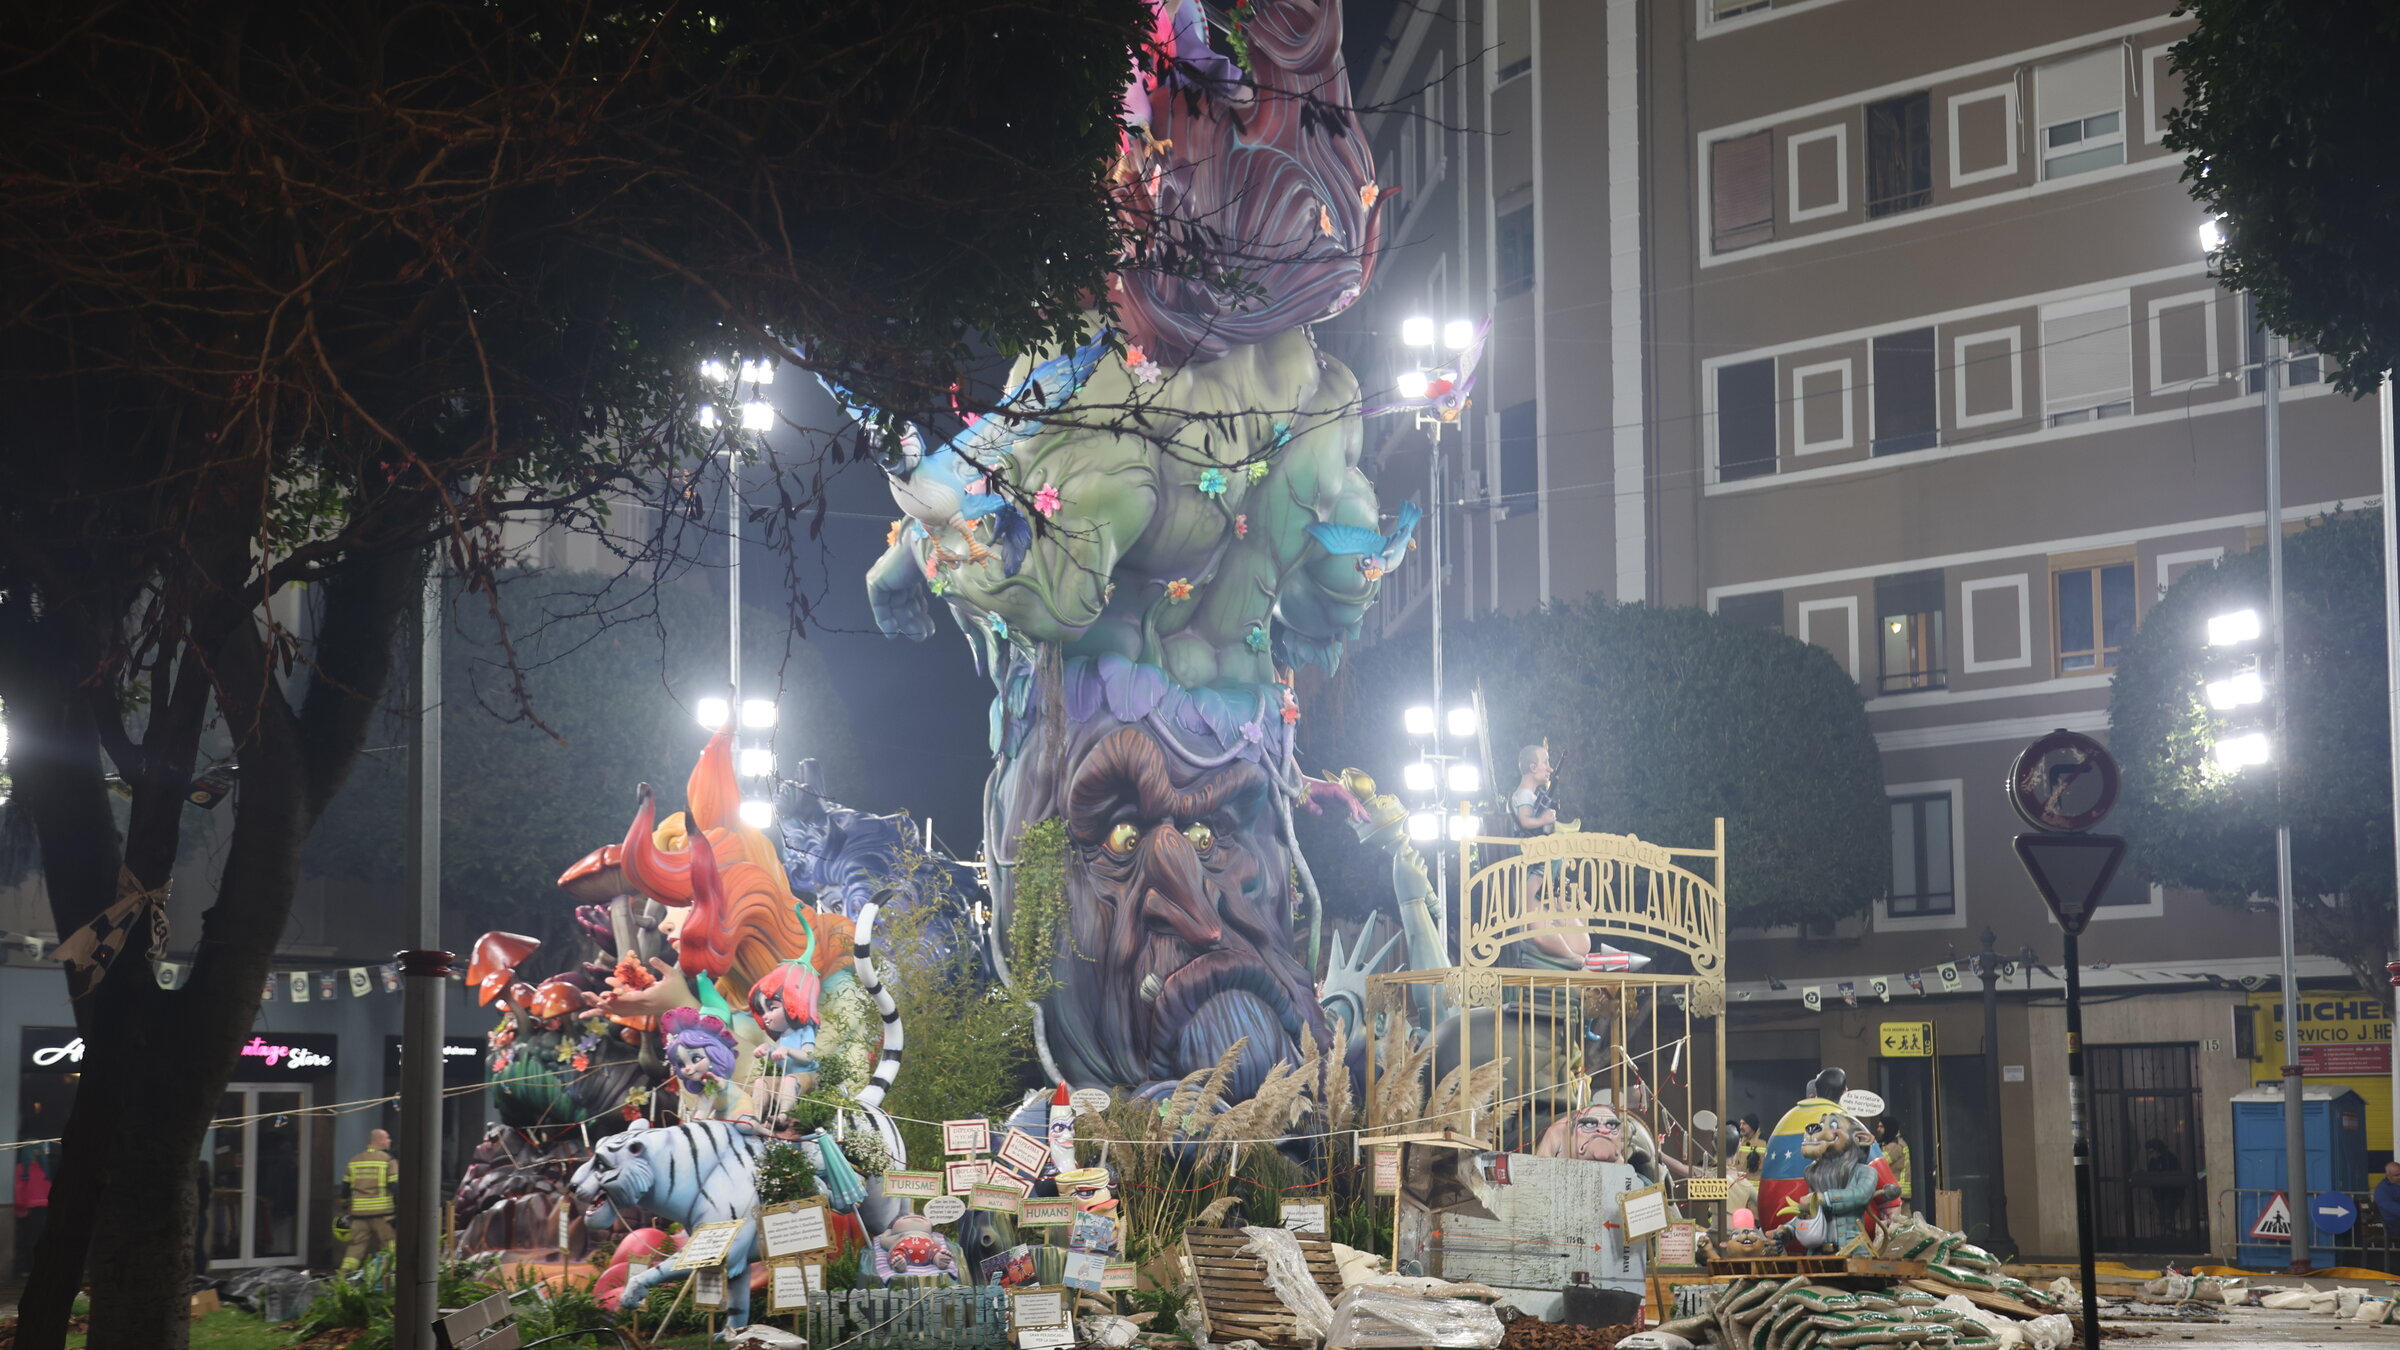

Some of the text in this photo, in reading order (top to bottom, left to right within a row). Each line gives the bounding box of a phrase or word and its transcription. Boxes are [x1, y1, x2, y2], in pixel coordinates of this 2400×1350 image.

[1525, 838, 1561, 860] ZOO
[1565, 837, 1613, 854] MOLT
[1471, 857, 1717, 950] JAULAGORILAMAN
[2274, 1028, 2349, 1043] SRVICIO
[2205, 1040, 2219, 1050] 15
[240, 1036, 333, 1070] ntage Store
[890, 1179, 936, 1191] TURISME
[1694, 1184, 1724, 1193] EIXIDA
[1026, 1207, 1070, 1218] HUMANS
